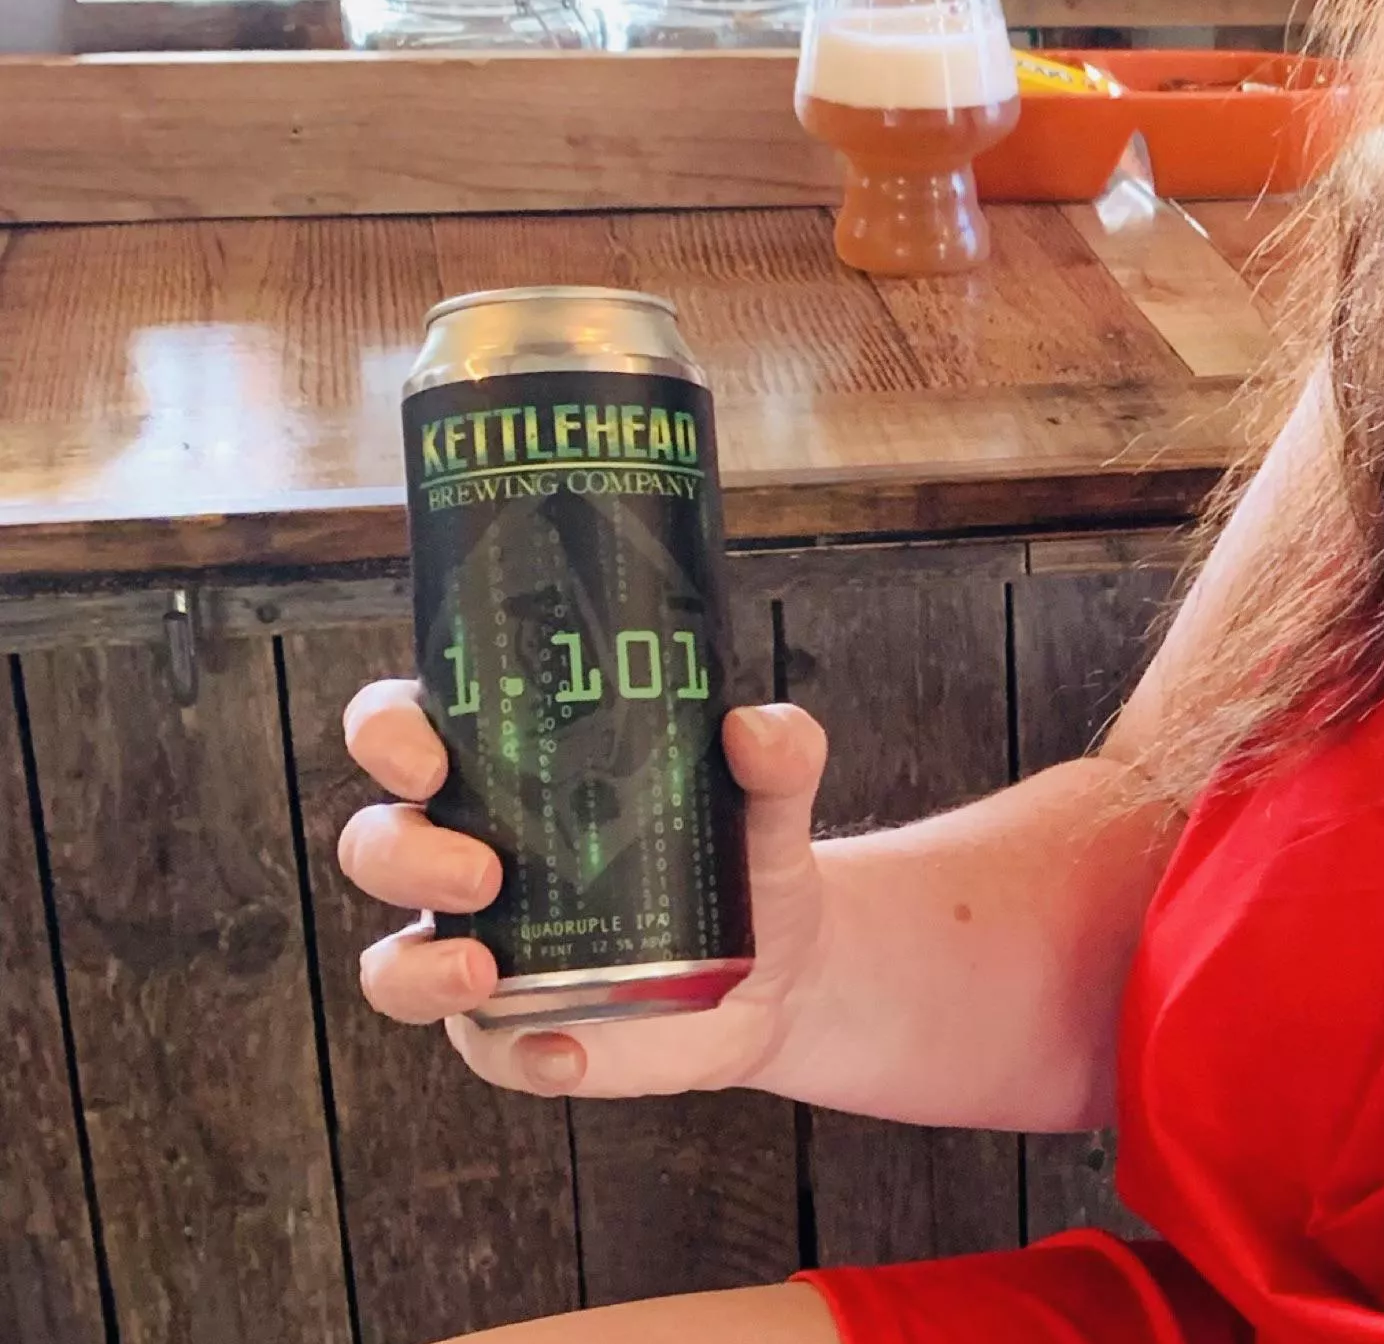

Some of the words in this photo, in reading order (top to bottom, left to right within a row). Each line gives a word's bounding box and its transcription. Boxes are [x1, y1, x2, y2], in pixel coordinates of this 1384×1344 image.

[421, 404, 698, 477] KETTLEHEAD
[428, 473, 559, 512] BREWING
[566, 470, 699, 500] COMPANY
[444, 630, 710, 717] 1.101
[520, 915, 623, 942] QUADRUPLE
[636, 912, 670, 931] IPA
